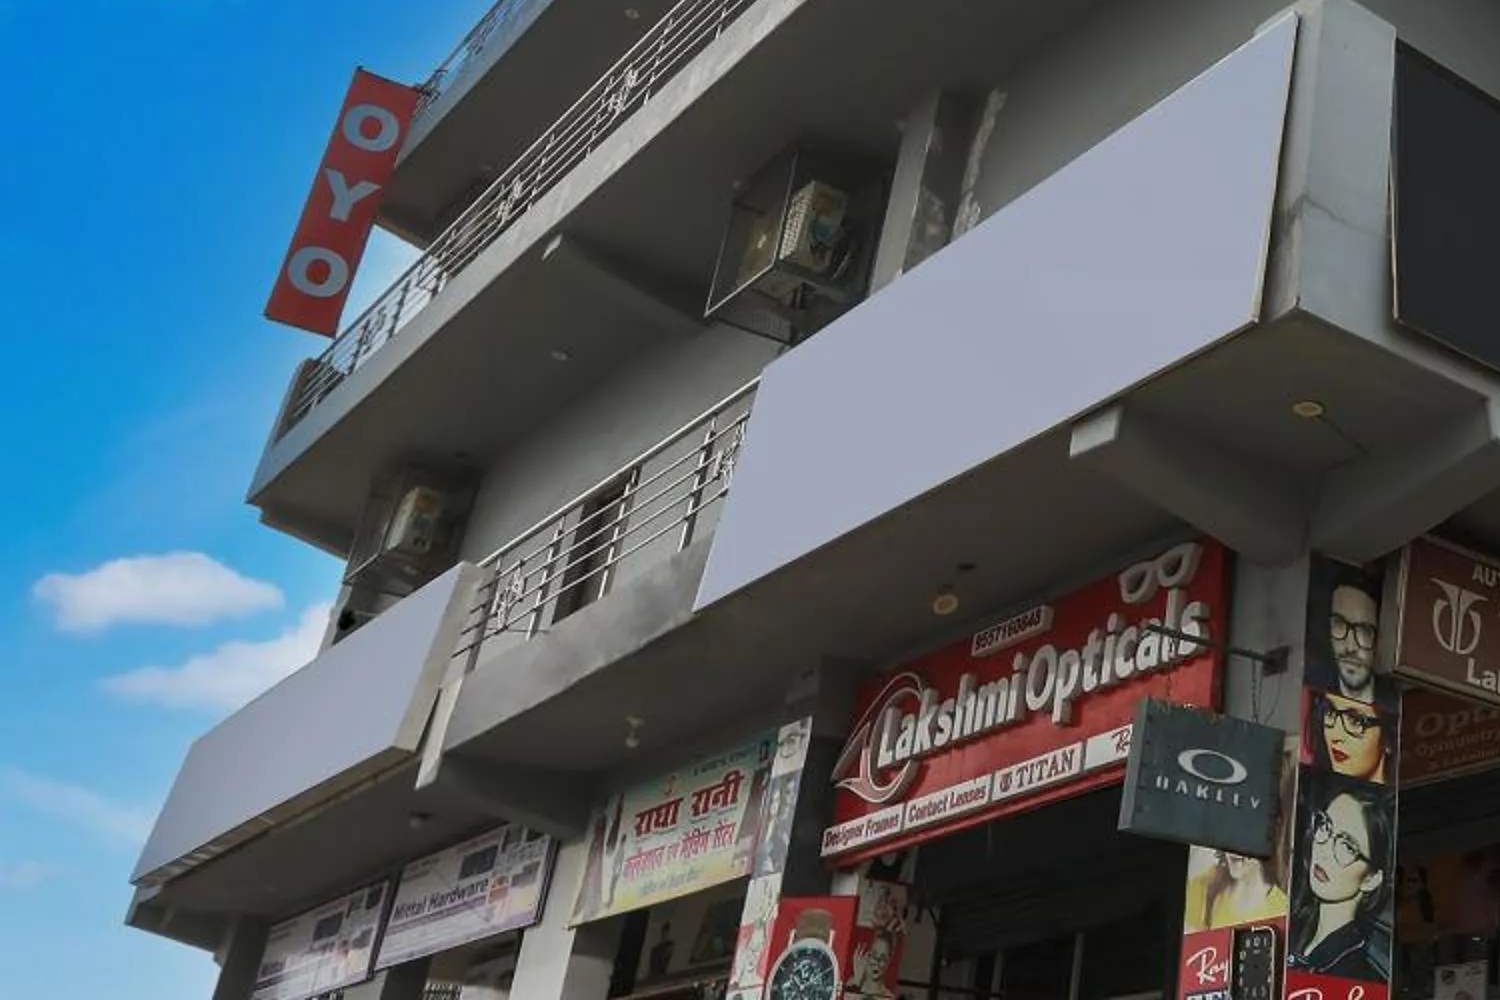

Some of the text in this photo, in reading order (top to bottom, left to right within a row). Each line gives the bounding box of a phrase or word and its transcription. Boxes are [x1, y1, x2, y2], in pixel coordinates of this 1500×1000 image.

[287, 103, 401, 298] OYO
[878, 588, 1211, 769] Lakshmi Opticals
[1016, 749, 1076, 788] TITAN
[908, 797, 948, 823] Contact
[428, 878, 490, 913] Hardware
